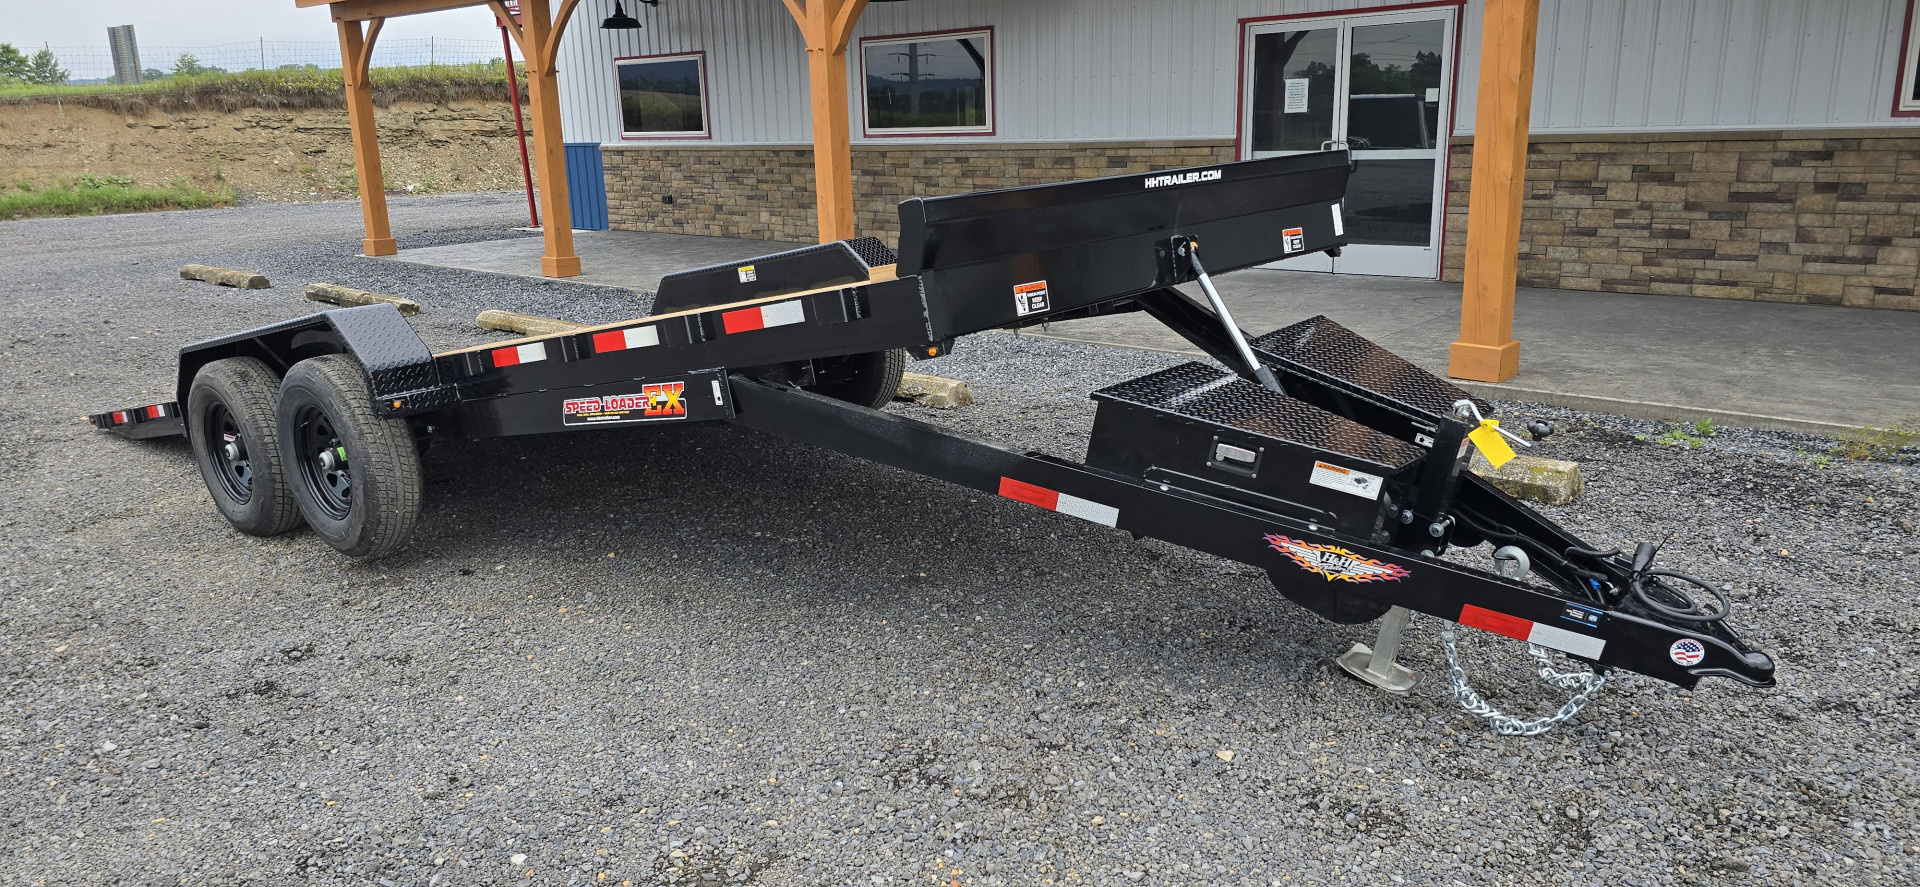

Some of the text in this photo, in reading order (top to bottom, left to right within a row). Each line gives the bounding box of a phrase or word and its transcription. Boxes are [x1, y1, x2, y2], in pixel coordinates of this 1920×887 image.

[1145, 170, 1221, 188] HHTRAILER.COM
[565, 400, 601, 414] SPEED
[604, 396, 651, 411] LOADER
[643, 382, 685, 416] EX
[1321, 552, 1354, 571] H&H
